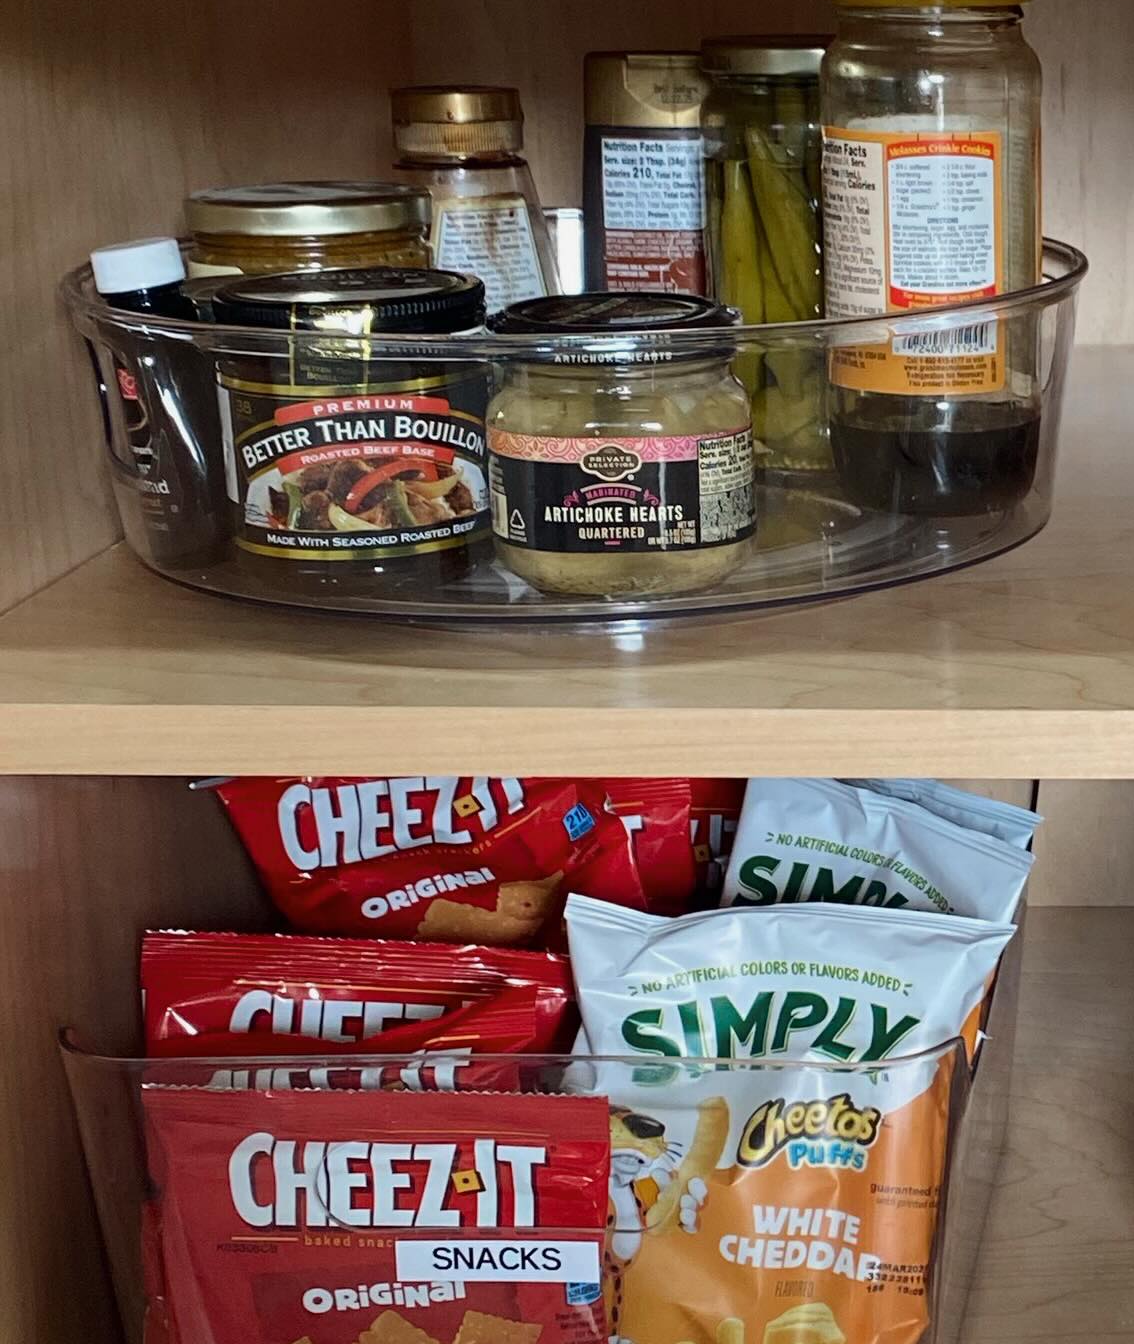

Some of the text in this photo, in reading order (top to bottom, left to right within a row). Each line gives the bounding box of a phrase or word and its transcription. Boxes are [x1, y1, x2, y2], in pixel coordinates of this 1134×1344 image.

[603, 141, 663, 153] Nutrition Facts
[844, 143, 867, 158] Facts
[848, 181, 875, 190] Calories
[950, 344, 979, 353] 71124
[313, 399, 413, 415] PREMIUM
[242, 416, 485, 469] BETTER THAN BOUILLON
[700, 439, 732, 450] Nutrition
[301, 446, 435, 465] ROASTED BEEF BASE
[700, 460, 727, 471] Calories
[586, 488, 636, 500] MARINATED
[544, 505, 683, 523] ARTICHOKE HEARTS
[267, 521, 476, 547] MADE WITH SEASONED ROASTED BEEF
[578, 527, 645, 539] QUARTERED
[776, 833, 793, 846] NO
[794, 836, 849, 856] ARTIFICIAL
[851, 848, 885, 867] COLORS
[641, 961, 901, 996] NO ARTIFICIAL COLORS OR FLAVORS ADDED
[621, 990, 920, 1068] SIMPLY
[737, 1093, 881, 1167] Cheetos
[788, 1139, 869, 1170] Puffs
[870, 1183, 931, 1197] guaranteed
[752, 1204, 861, 1245] WHITE
[305, 1235, 351, 1247] baked
[432, 1246, 562, 1271] SNACKS
[719, 1234, 881, 1283] CHEDDAR
